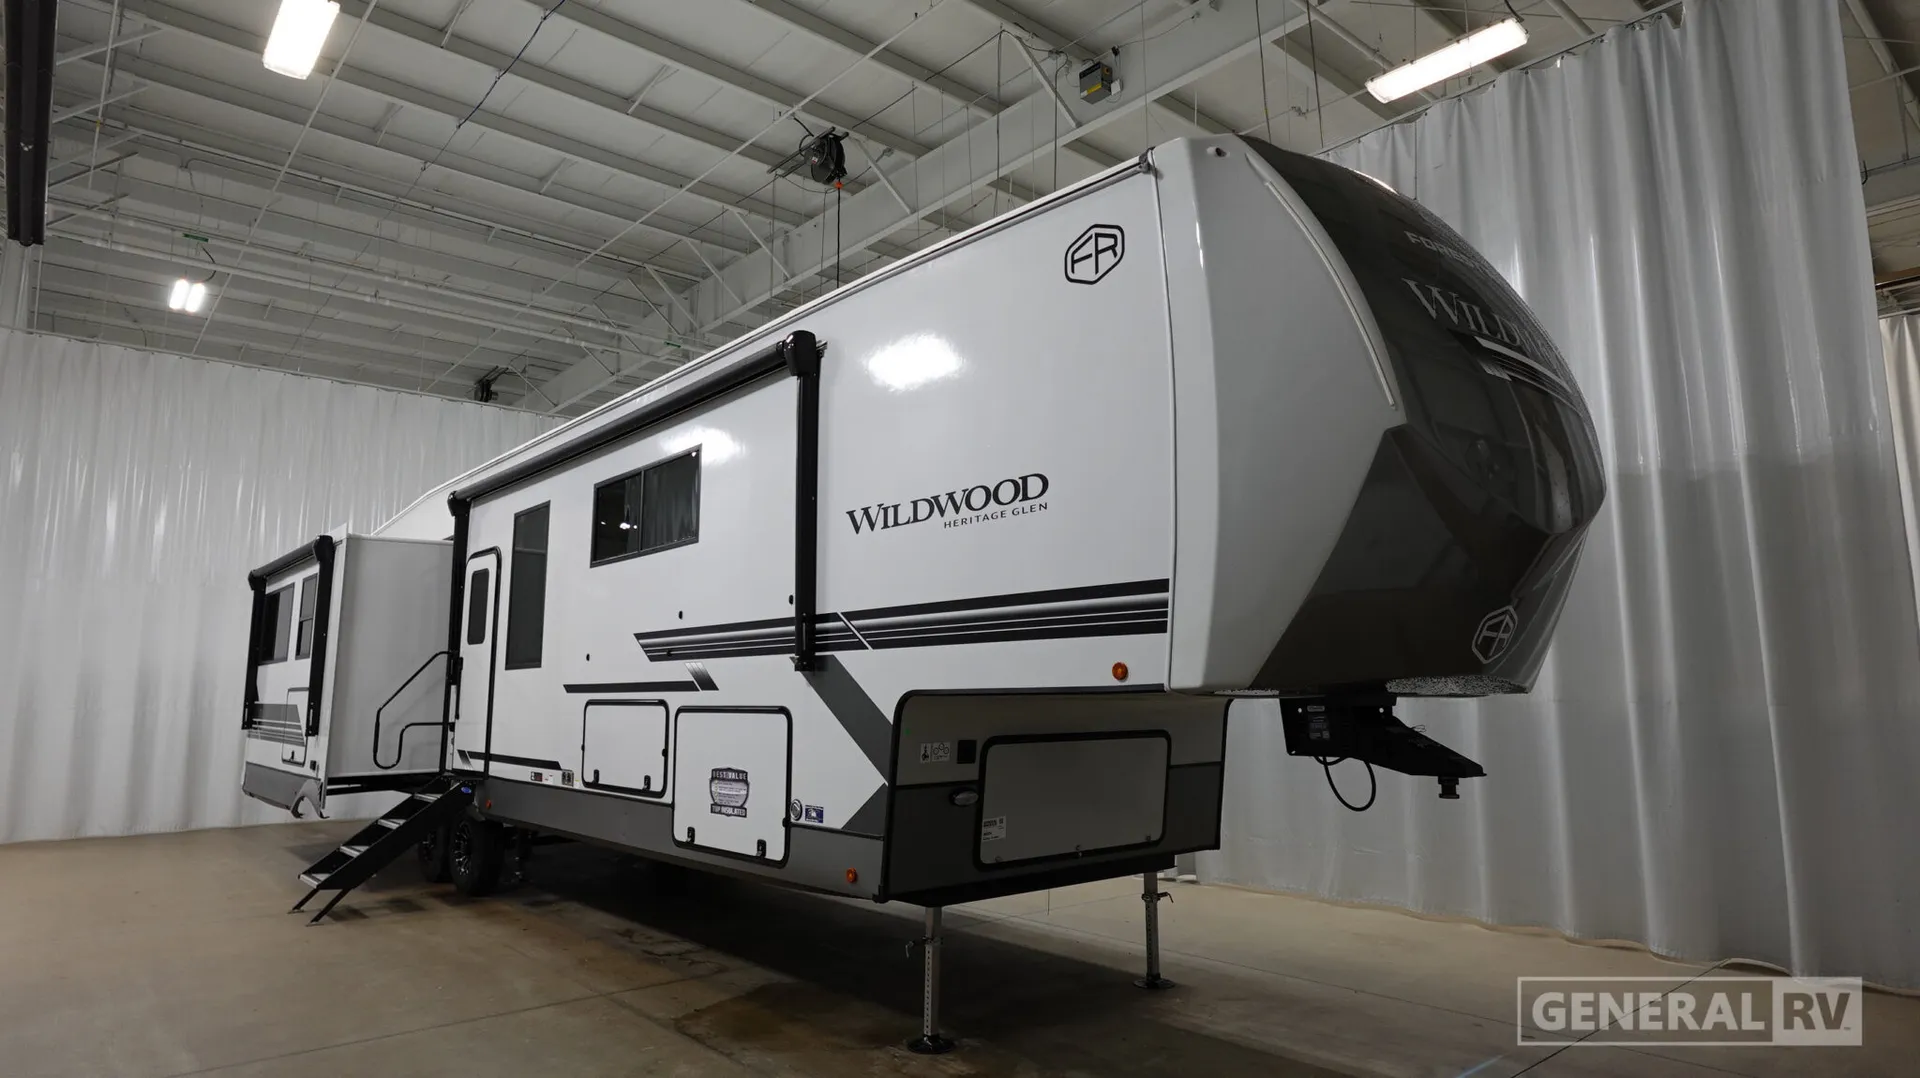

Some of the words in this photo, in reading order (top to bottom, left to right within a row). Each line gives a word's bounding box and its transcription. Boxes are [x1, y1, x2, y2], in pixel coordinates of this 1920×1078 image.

[846, 472, 1050, 535] WILDWOOD
[944, 509, 1007, 529] HERITAGE
[1011, 502, 1048, 517] GLEN
